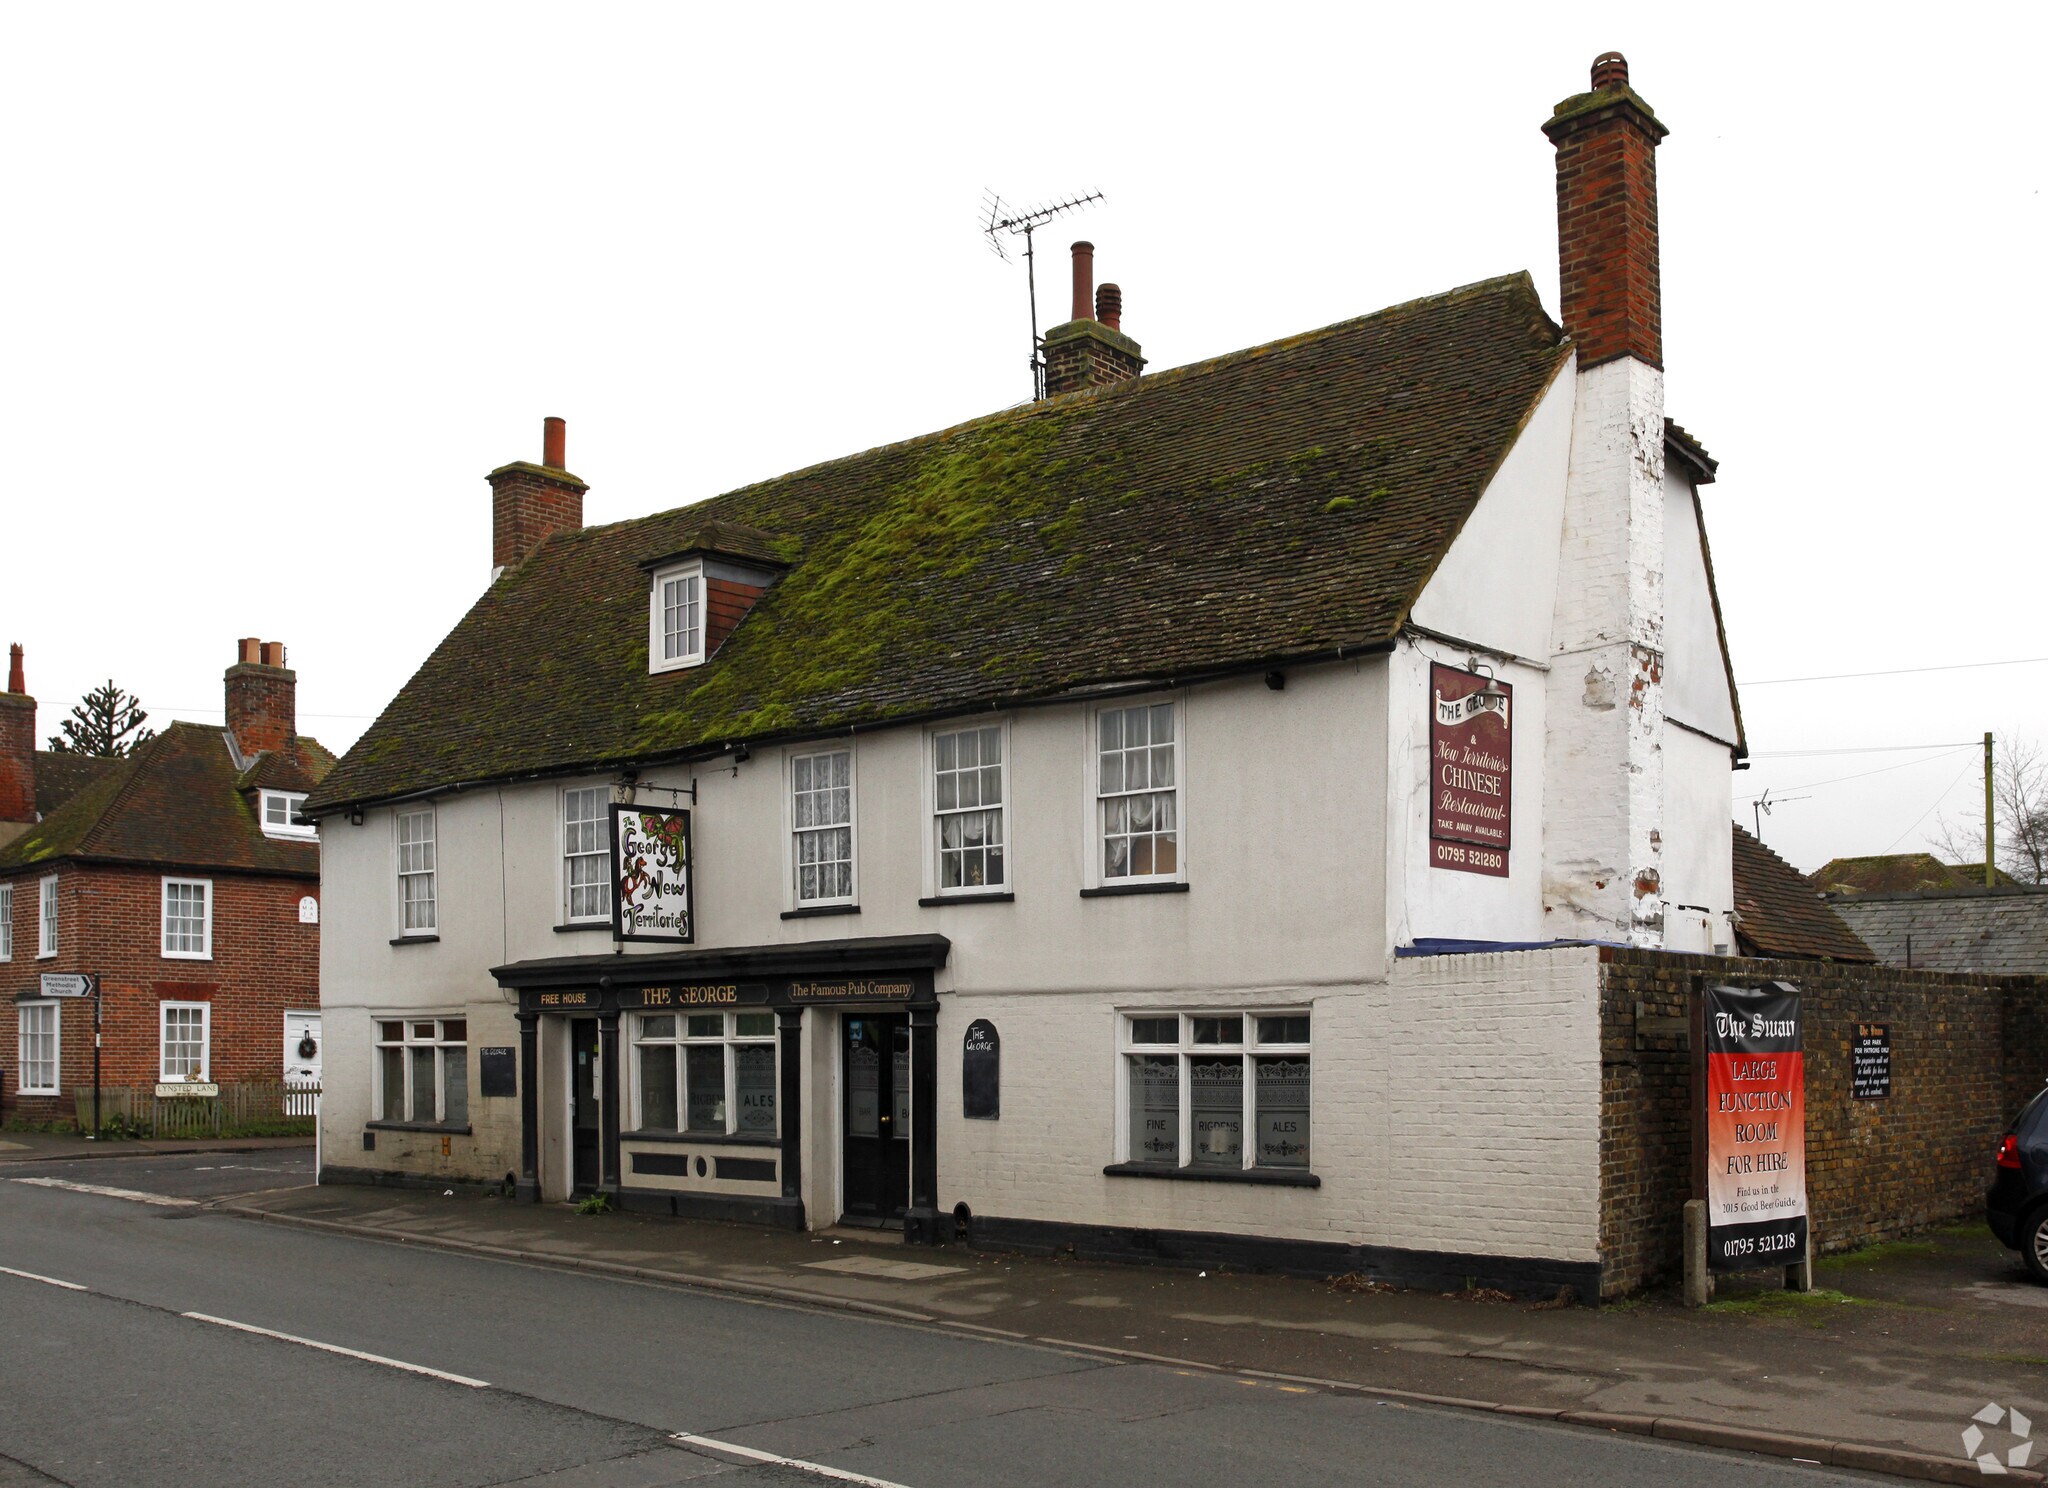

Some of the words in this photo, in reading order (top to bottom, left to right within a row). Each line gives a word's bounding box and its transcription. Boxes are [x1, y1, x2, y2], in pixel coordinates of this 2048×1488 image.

[1439, 703, 1461, 719] THE
[1466, 695, 1504, 713] GEOE
[1470, 734, 1477, 745] &
[1435, 740, 1459, 761] New
[1460, 746, 1508, 773] Territories
[1442, 764, 1502, 797] CHINESE
[1438, 790, 1506, 820] Restaurant
[1438, 819, 1453, 830] TAKE
[1456, 822, 1473, 833] AWAY
[622, 827, 678, 867] George
[1438, 845, 1465, 863] 01795
[1469, 850, 1502, 868] 521280
[642, 870, 685, 900] New
[623, 903, 687, 936] Territories
[541, 994, 559, 1005] FREE
[563, 993, 587, 1004] HOUSE
[642, 988, 671, 1005] THE
[679, 986, 737, 1004] GEORGE
[792, 983, 809, 997] The
[811, 983, 846, 996] Famous
[848, 982, 867, 995] Pub
[868, 981, 911, 998] Company
[971, 1027, 985, 1041] THE
[1715, 1012, 1747, 1043] The
[1751, 1013, 1795, 1038] Swan
[966, 1039, 995, 1052] GEORGE
[1732, 1061, 1777, 1081] LARGE
[743, 1095, 775, 1108] ALES
[1719, 1090, 1792, 1113] FUNCTION
[1146, 1119, 1166, 1130] FINE
[1272, 1121, 1297, 1133] ALES
[1735, 1122, 1778, 1144] ROOM
[1727, 1155, 1752, 1175] FOR
[1756, 1151, 1788, 1173] HIRE
[1736, 1186, 1751, 1198] Find
[1752, 1187, 1760, 1196] us
[1762, 1185, 1769, 1195] in
[1771, 1184, 1779, 1194] the
[1741, 1201, 1759, 1213] Good
[1760, 1200, 1775, 1211] Beer
[1775, 1197, 1796, 1209] Guide
[1724, 1237, 1754, 1257] 01795
[1758, 1232, 1796, 1253] 521218
